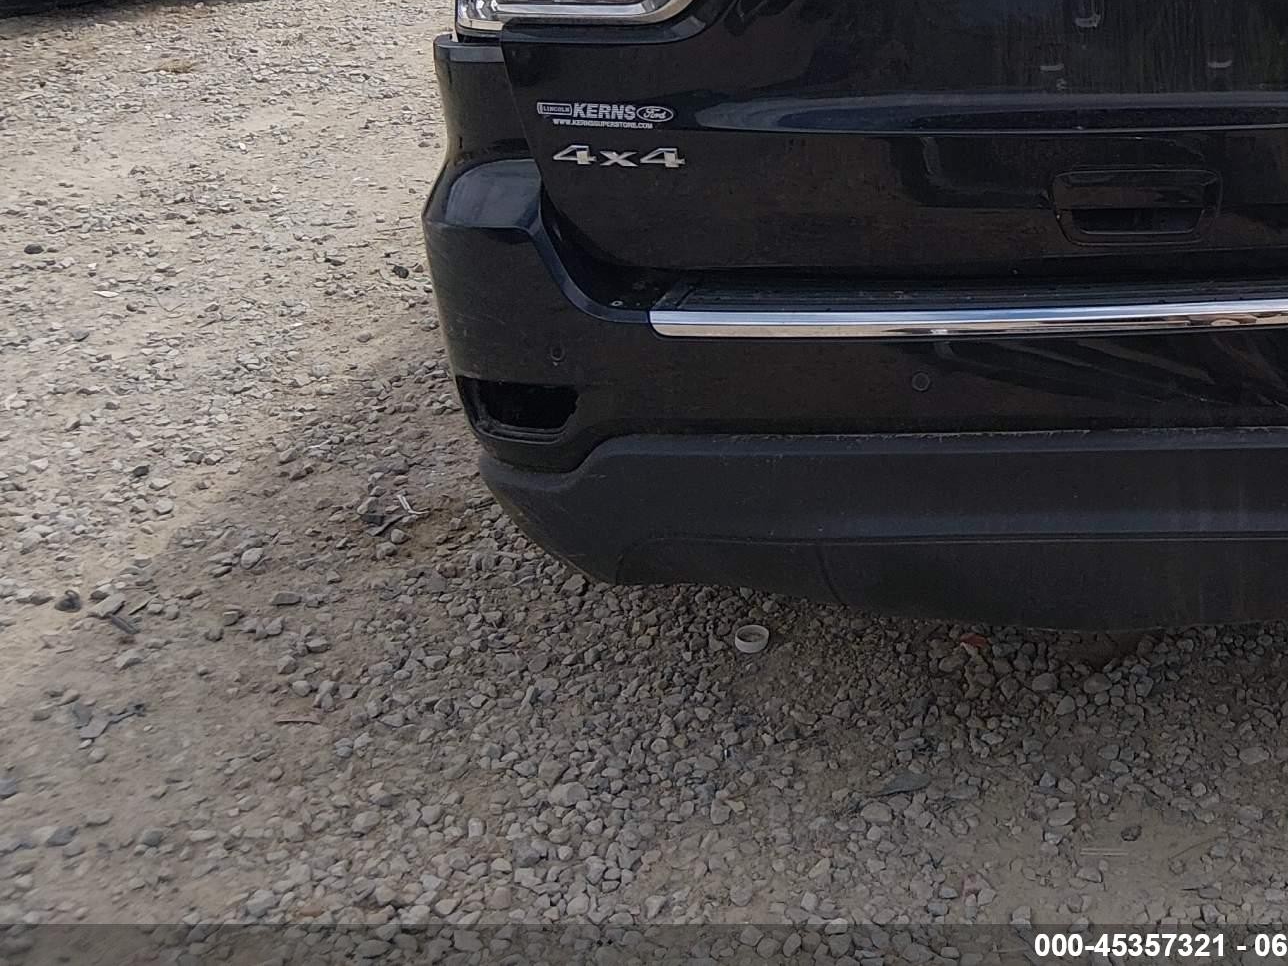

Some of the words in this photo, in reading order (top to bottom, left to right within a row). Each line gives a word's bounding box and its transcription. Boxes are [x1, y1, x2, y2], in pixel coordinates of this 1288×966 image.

[542, 105, 570, 113] LINCOLN
[573, 103, 636, 120] KERNS
[643, 108, 667, 119] Ford
[553, 144, 686, 168] 4x4
